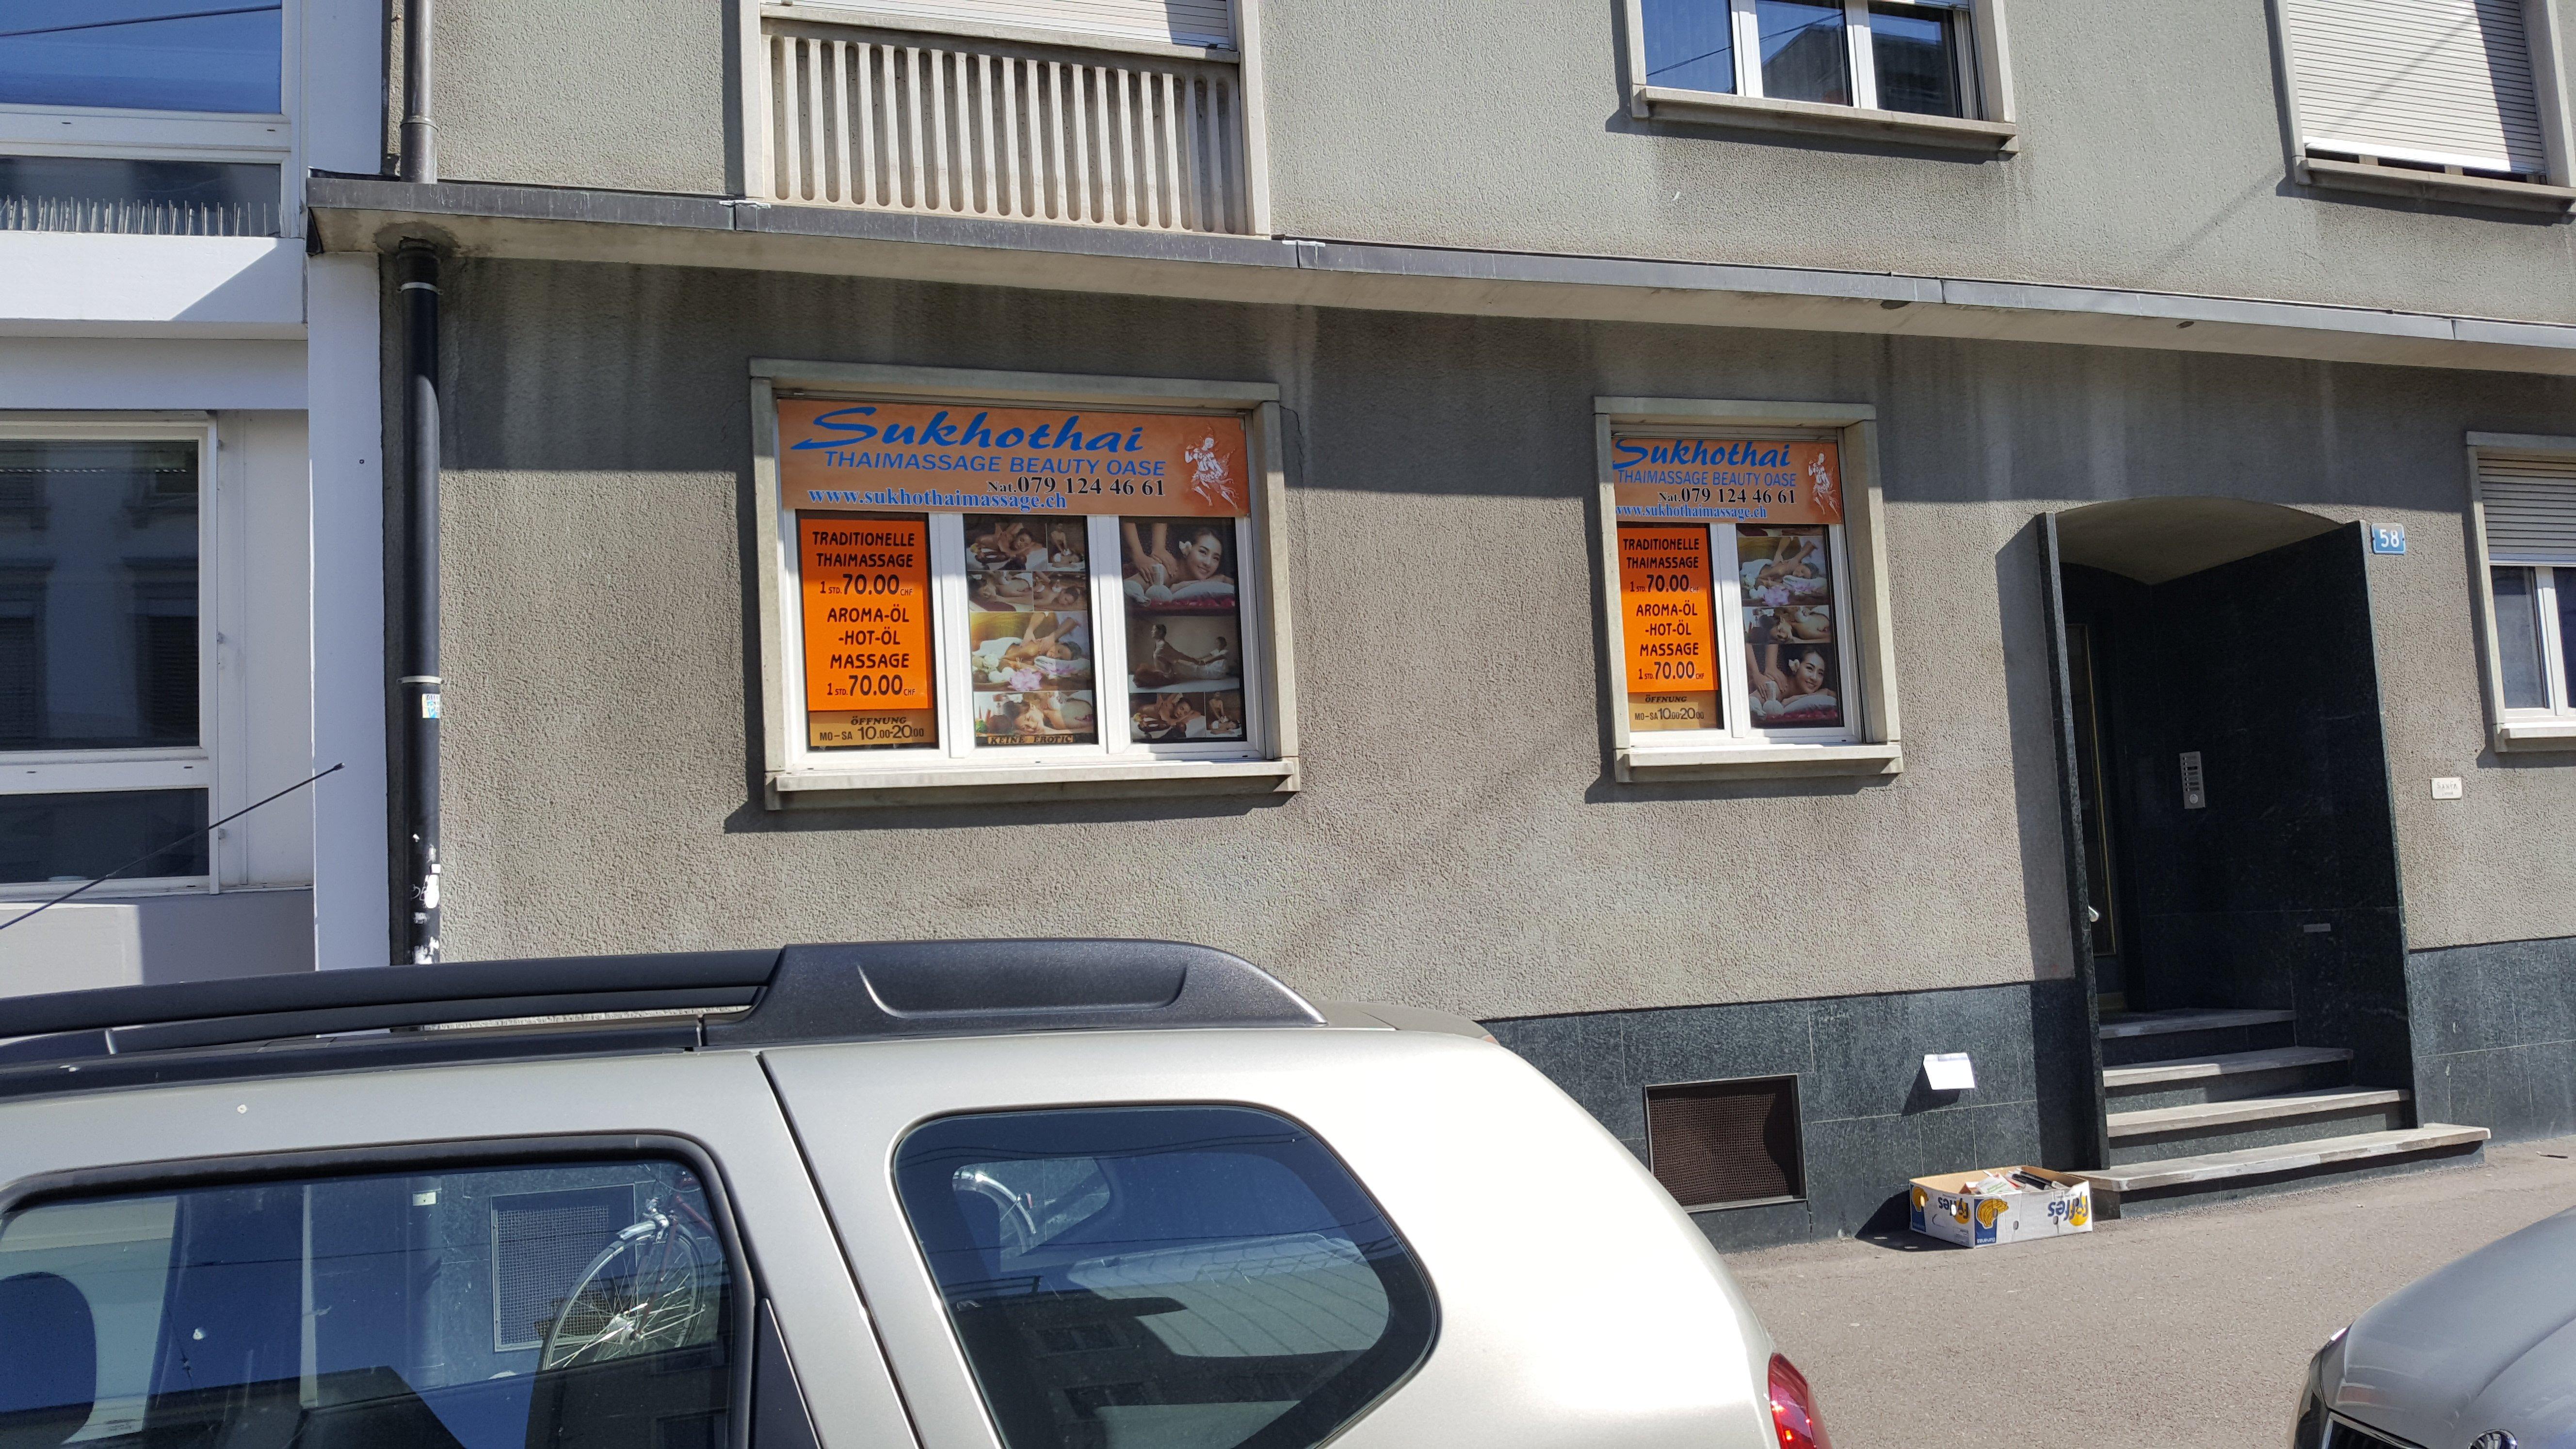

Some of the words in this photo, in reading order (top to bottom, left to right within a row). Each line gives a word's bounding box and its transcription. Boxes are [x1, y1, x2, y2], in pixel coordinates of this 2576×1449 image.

[790, 407, 1143, 452] Sukhothai
[1612, 439, 1790, 469] Sukhothai
[825, 451, 1002, 472] THAIMASSAGE
[1010, 457, 1100, 475] BEAUTY
[1107, 460, 1166, 476] OASE
[1017, 476, 1056, 493] 079
[1066, 477, 1102, 494] 124
[1110, 478, 1135, 495] 46
[1142, 479, 1166, 496] 61
[1618, 470, 1708, 485] THAIMASSAGE
[1713, 472, 1760, 485] BEAUTY
[1764, 473, 1797, 486] OASE
[807, 488, 1067, 512] www.sukhothaimassage.ch
[1681, 487, 1711, 503] 079
[1719, 488, 1746, 503] 124
[1753, 489, 1771, 503] 46
[1778, 489, 1796, 503] 61
[812, 531, 915, 547] TRADITIONELLE
[1623, 538, 1699, 550] TRADITIONELLE
[2379, 529, 2399, 548] 58
[816, 553, 913, 567] THAIMASSAGE
[1626, 557, 1699, 569] THAIMASSAGE
[820, 581, 826, 594] 1
[843, 574, 900, 595] 70.00
[1630, 581, 1635, 592] 1
[1646, 574, 1689, 592] 70.00
[827, 604, 909, 623] AROMA-ÖL
[1636, 600, 1697, 616] AROMA-ÖL
[838, 627, 901, 645] -HOT-ÖL
[1645, 619, 1691, 636] -HOT-ÖL
[1640, 643, 1699, 656] MASSAGE
[830, 653, 909, 669] MASSAGE
[1638, 668, 1643, 679] 1
[1654, 661, 1695, 679] 70.00
[827, 683, 833, 695] 1
[849, 675, 903, 696] 70.00
[851, 716, 906, 725] ÖFFNUNG
[990, 736, 1026, 744] KEINE
[1033, 735, 1073, 743] EROTIC
